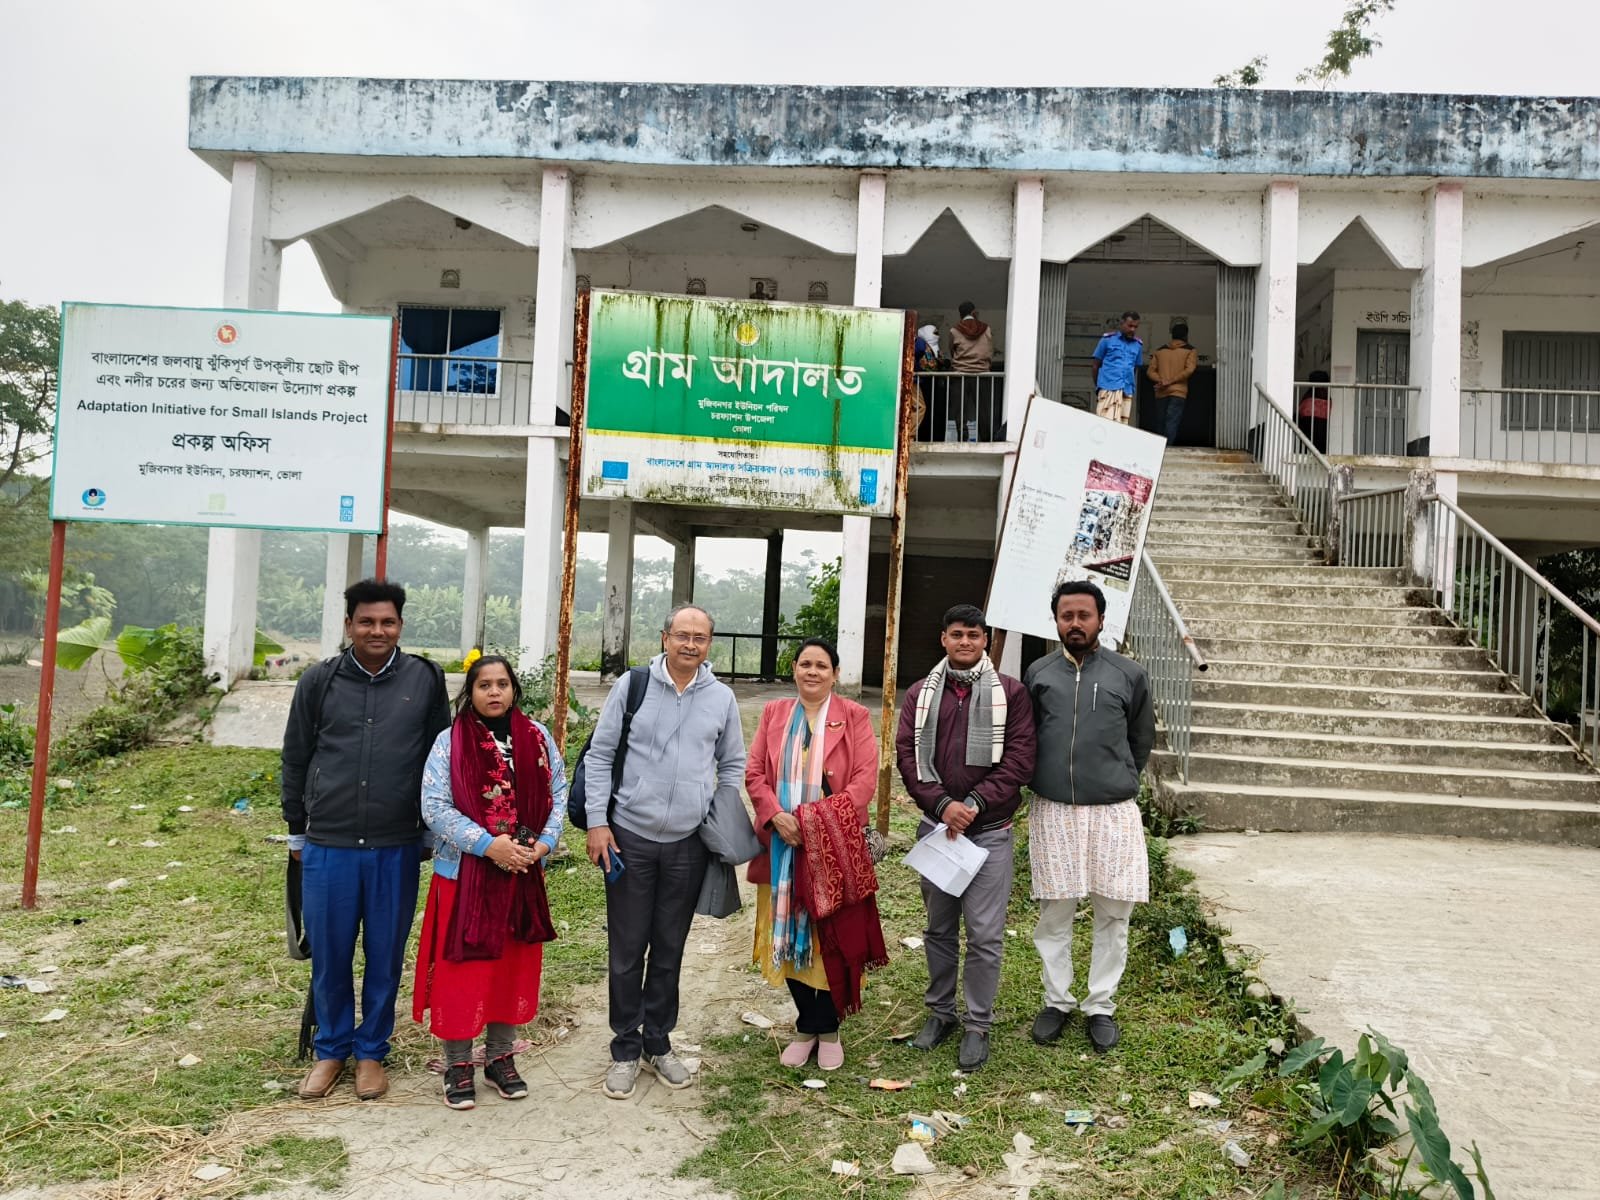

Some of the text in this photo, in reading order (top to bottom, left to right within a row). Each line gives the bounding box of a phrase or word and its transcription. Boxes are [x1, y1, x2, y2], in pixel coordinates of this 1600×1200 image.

[1366, 311, 1388, 322] ইউপি
[91, 351, 359, 376] বাংলাদেশের জলবায়ু ঝুঁকিপূর্ণ উপকূলীয় ছোট দ্বীপ
[623, 346, 866, 398] গ্রাম আদালত
[97, 372, 357, 398] এবং নদীর চরের জন্য অভিযোজন উদ্যোগ প্রকল্প
[77, 400, 367, 425] Adaptation Initiative for Small Islands Project
[698, 398, 732, 409] মুজিবনগর
[735, 400, 762, 411] ইউনিয়ন
[745, 413, 774, 423] উপজেলা
[732, 425, 752, 433] ভোলা
[172, 432, 270, 453] প্রকল্প অফিস
[139, 462, 302, 481] মুজিবনগর ইউনিয়ন, চরফ্যাশন, ভোলা
[647, 457, 684, 469] বাংলাদেশে
[688, 461, 702, 470] গ্রাম
[705, 461, 735, 472] আদালত
